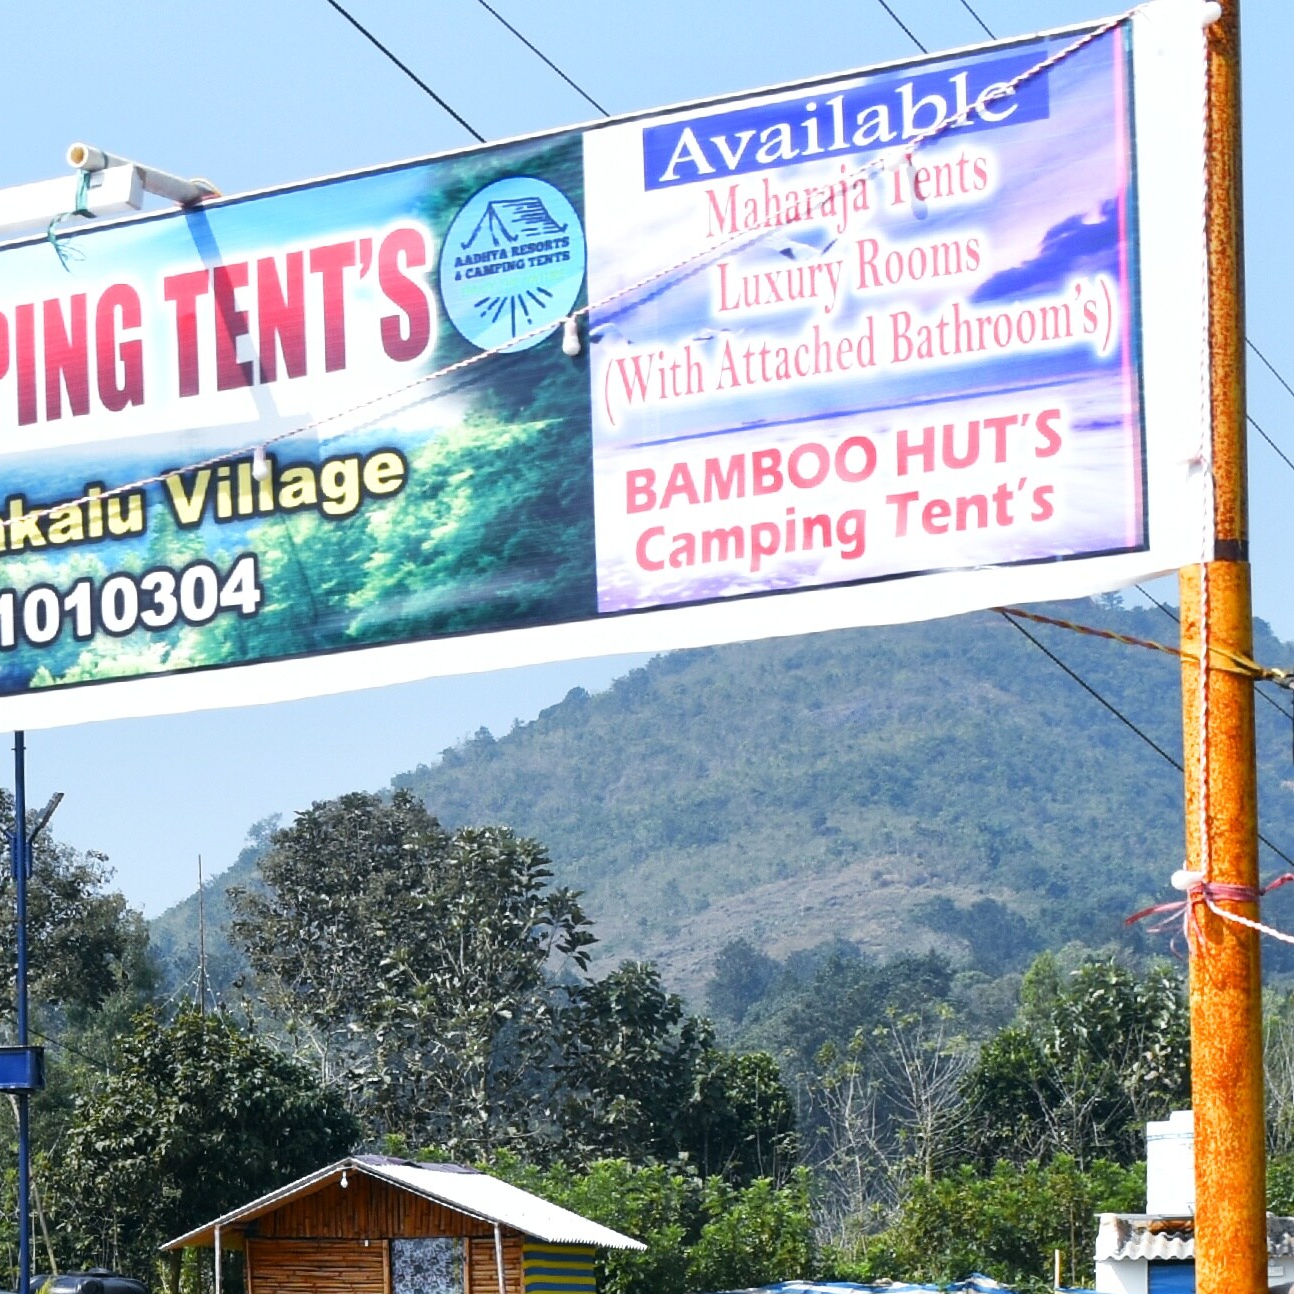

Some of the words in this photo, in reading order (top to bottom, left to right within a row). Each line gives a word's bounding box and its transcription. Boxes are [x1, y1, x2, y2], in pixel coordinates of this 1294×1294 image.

[659, 71, 1018, 182] Available
[705, 164, 870, 237] Maharaja
[886, 149, 989, 206] Tents
[454, 248, 508, 267] AADHYA
[511, 236, 570, 257] RESORTS
[465, 259, 526, 279] CAMPING
[528, 250, 570, 267] TENTS
[717, 258, 844, 313] Luxury
[856, 236, 981, 290] Rooms
[163, 228, 432, 398] TENT'S
[605, 344, 705, 426] (With
[716, 326, 876, 391] Attached
[890, 279, 1113, 365] Bathroom's)
[165, 451, 405, 525] Village
[625, 435, 878, 514] BAMBOO
[896, 409, 1063, 476] HUT'S
[635, 507, 867, 572] Camping
[885, 477, 1055, 538] Tent's
